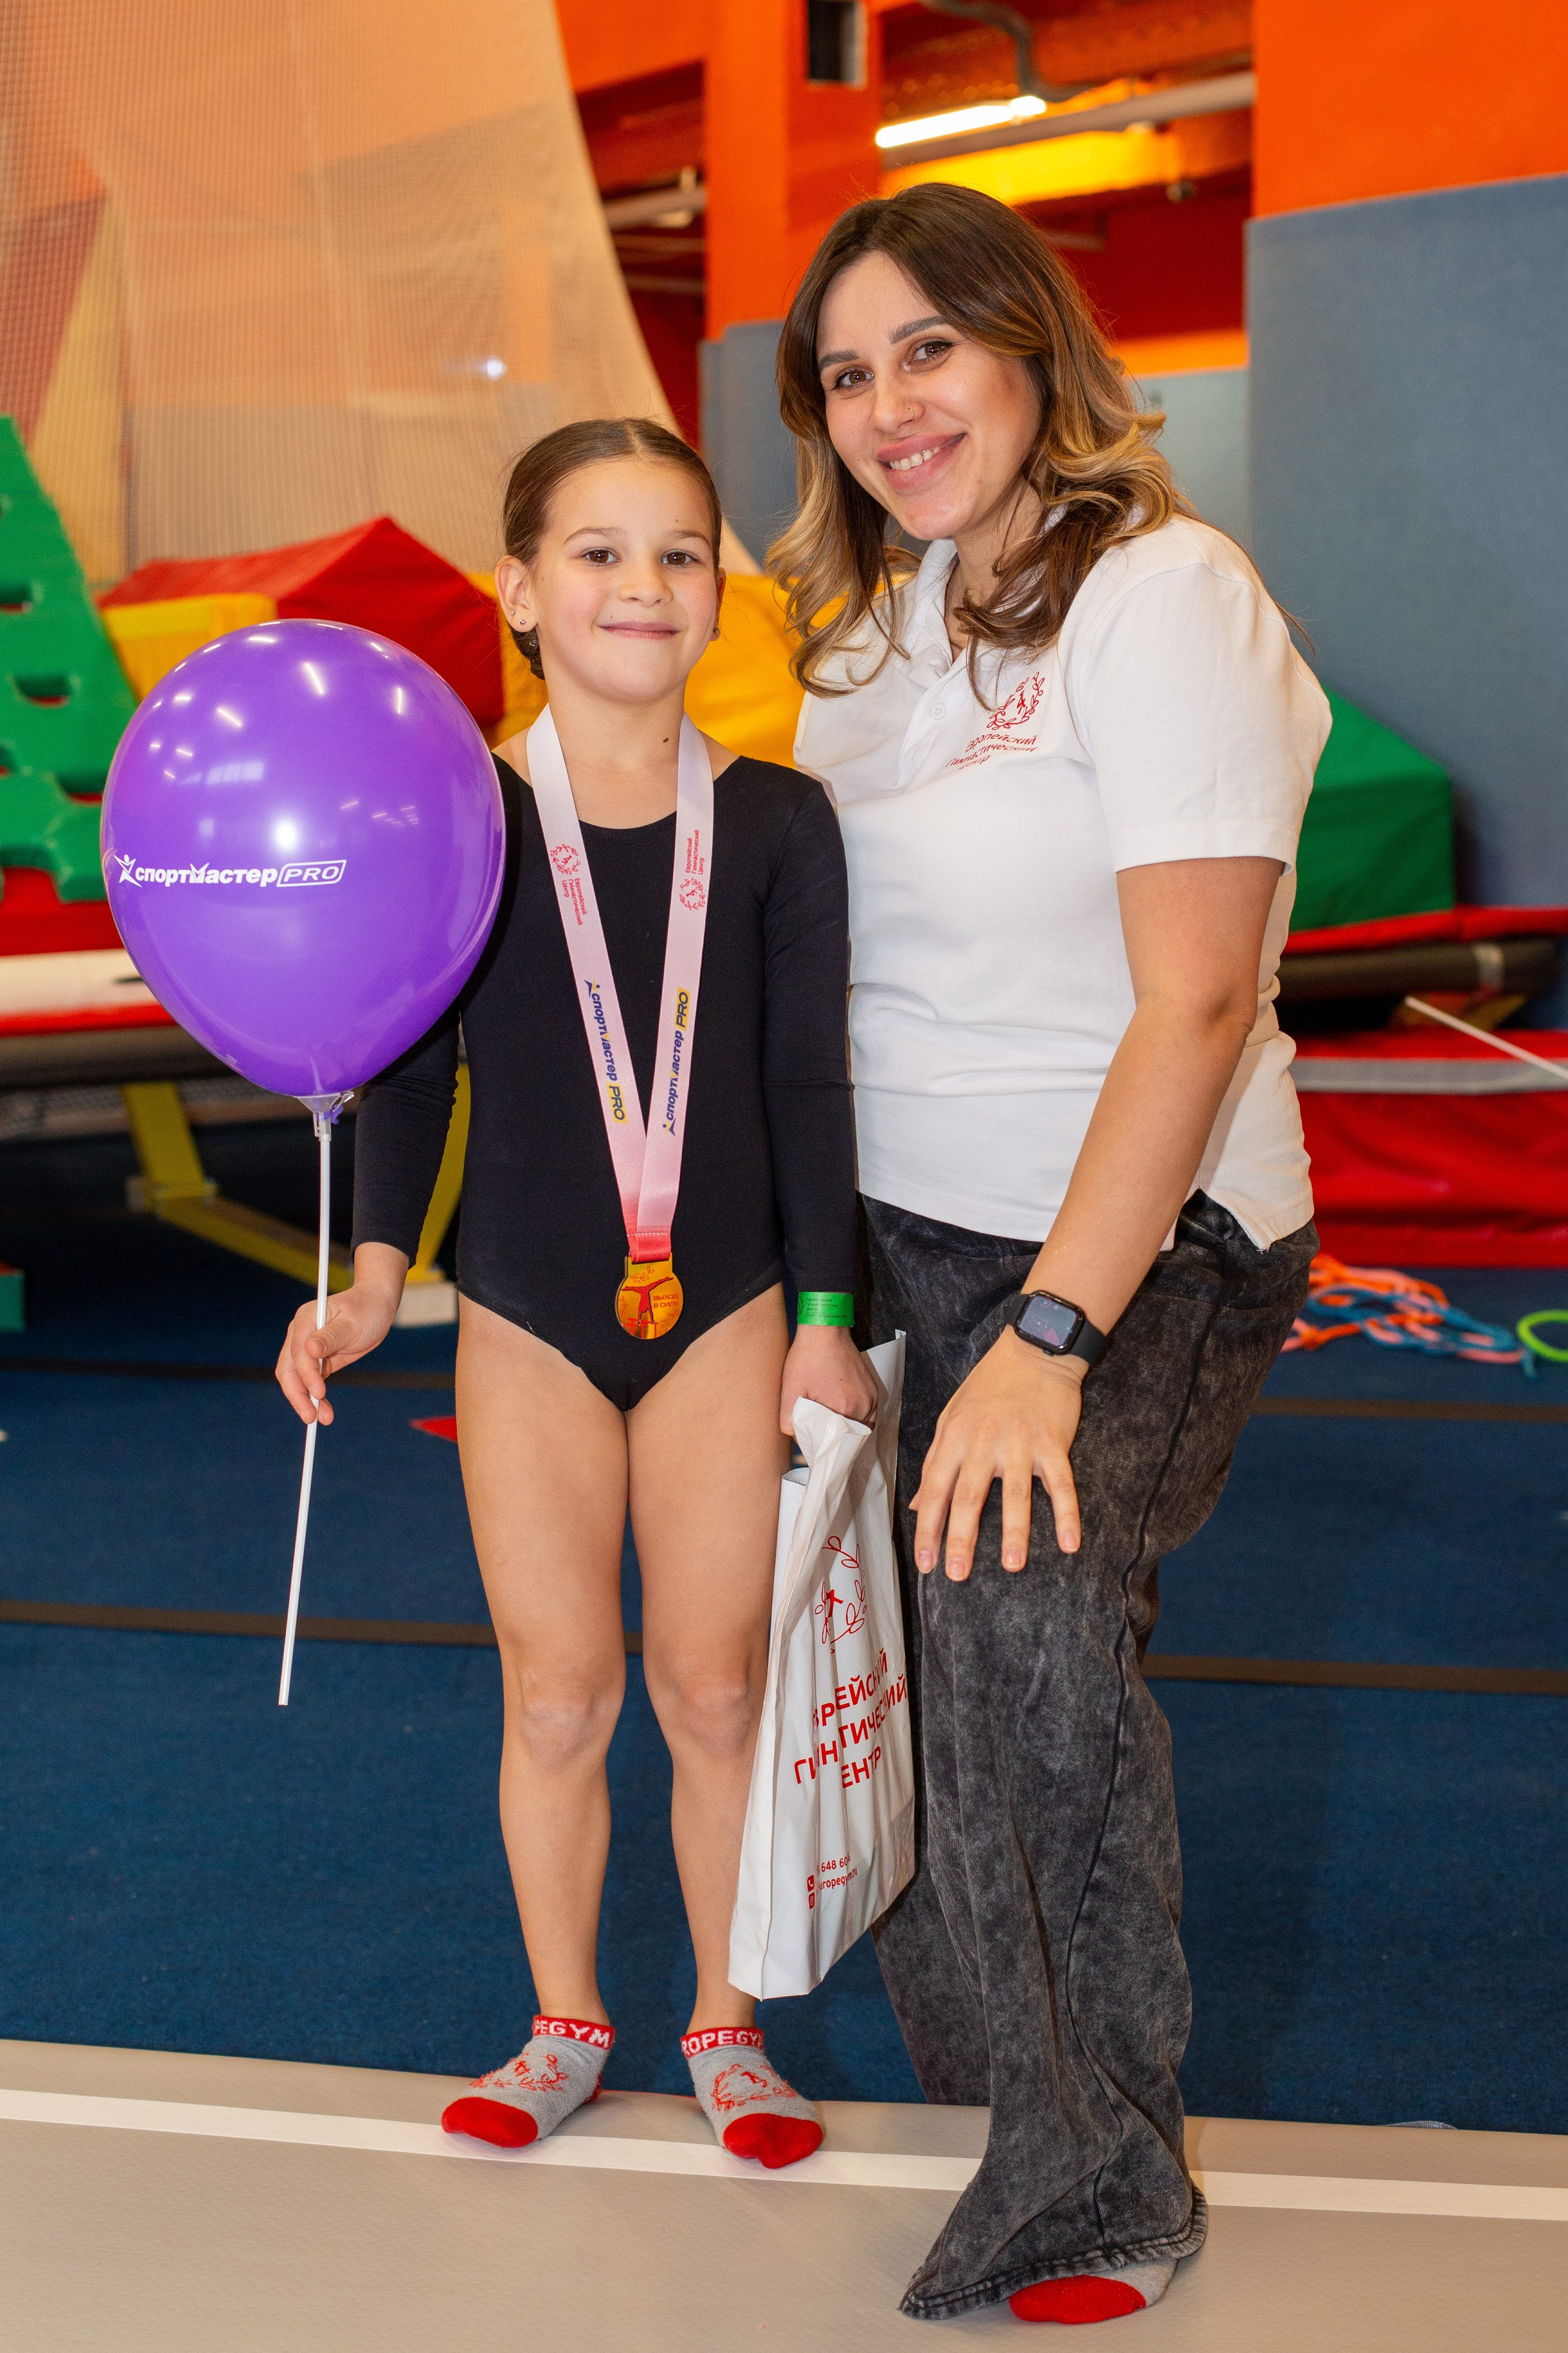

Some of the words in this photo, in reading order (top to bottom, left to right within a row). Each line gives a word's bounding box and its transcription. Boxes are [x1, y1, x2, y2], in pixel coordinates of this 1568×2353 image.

[283, 866, 339, 882] PRO
[568, 878, 583, 926] Гимнастический
[575, 878, 587, 915] Европейский
[676, 991, 688, 1028] PRO
[609, 1085, 625, 1120] PRO
[841, 1746, 881, 1788] ЕНТР
[821, 1860, 837, 1872] 648
